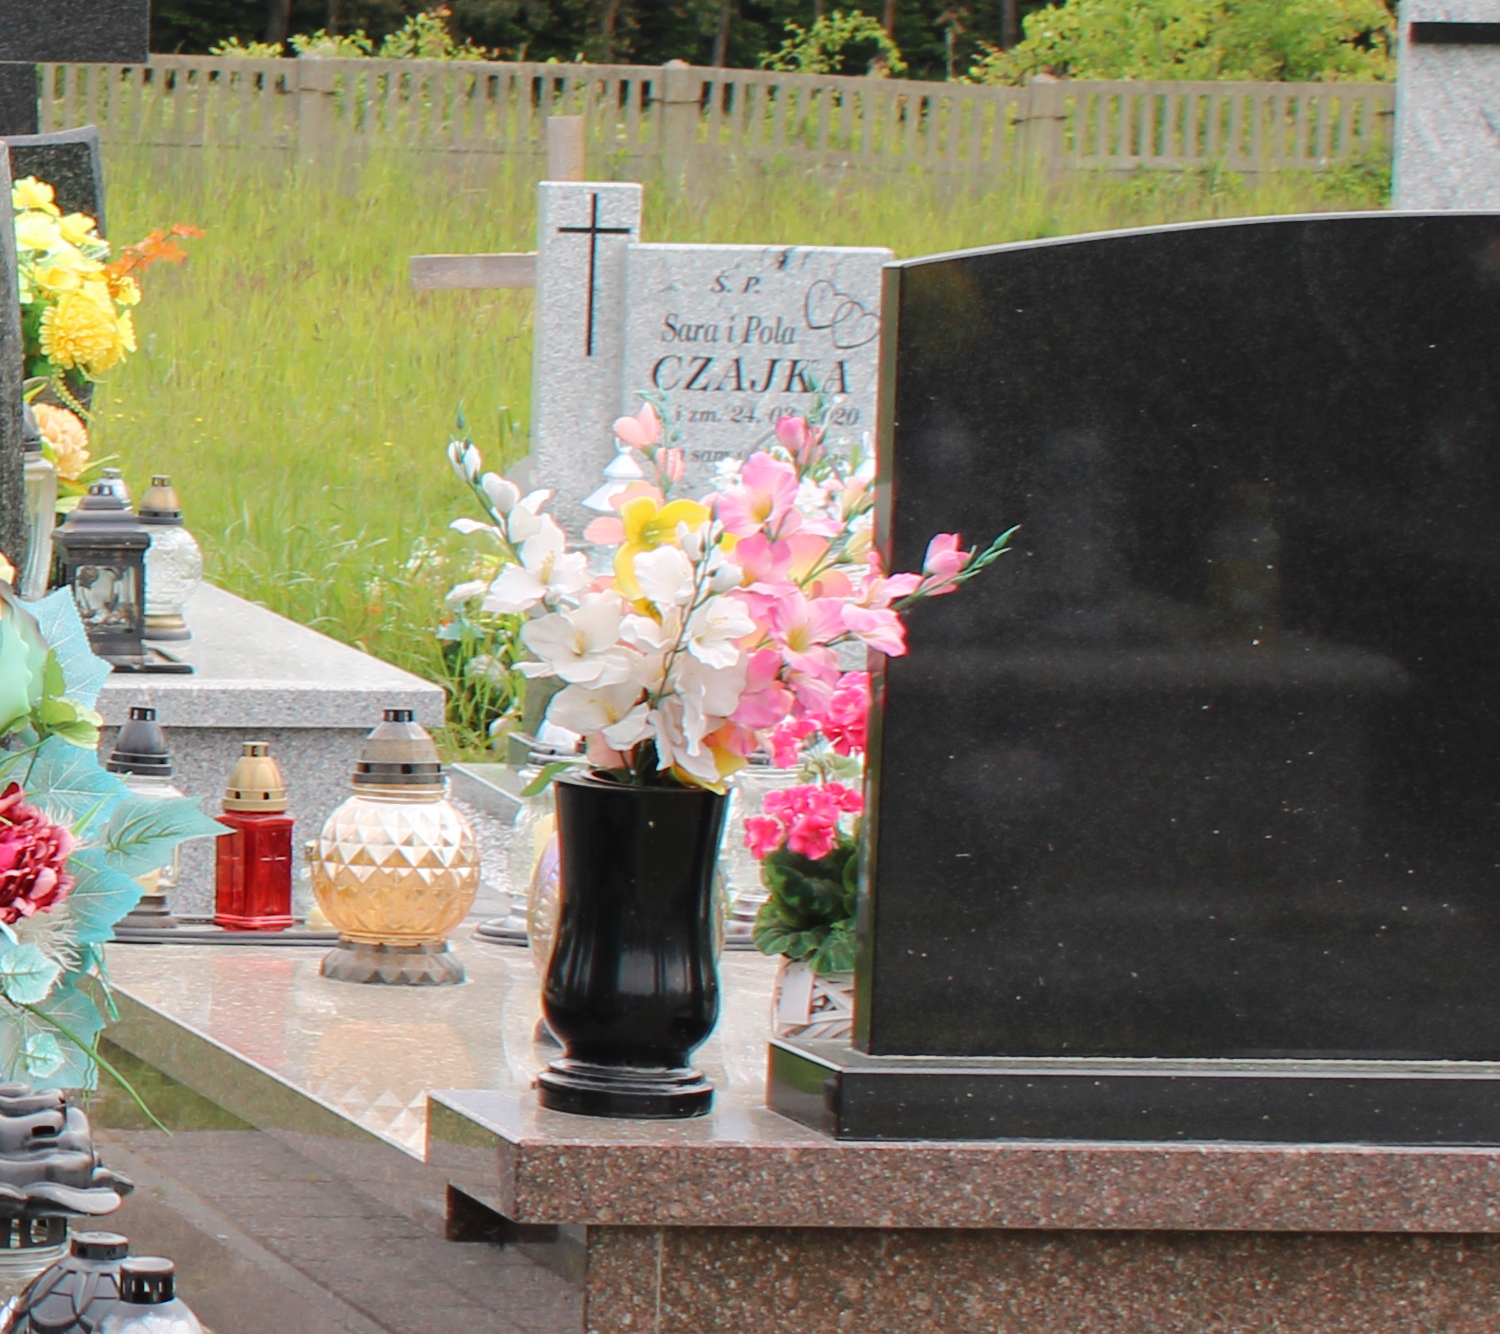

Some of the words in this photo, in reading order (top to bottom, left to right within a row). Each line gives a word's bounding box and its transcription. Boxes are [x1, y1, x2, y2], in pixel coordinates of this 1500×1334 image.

[661, 313, 719, 343] Sara
[742, 316, 797, 344] Pola
[652, 354, 852, 394] CZAJKA
